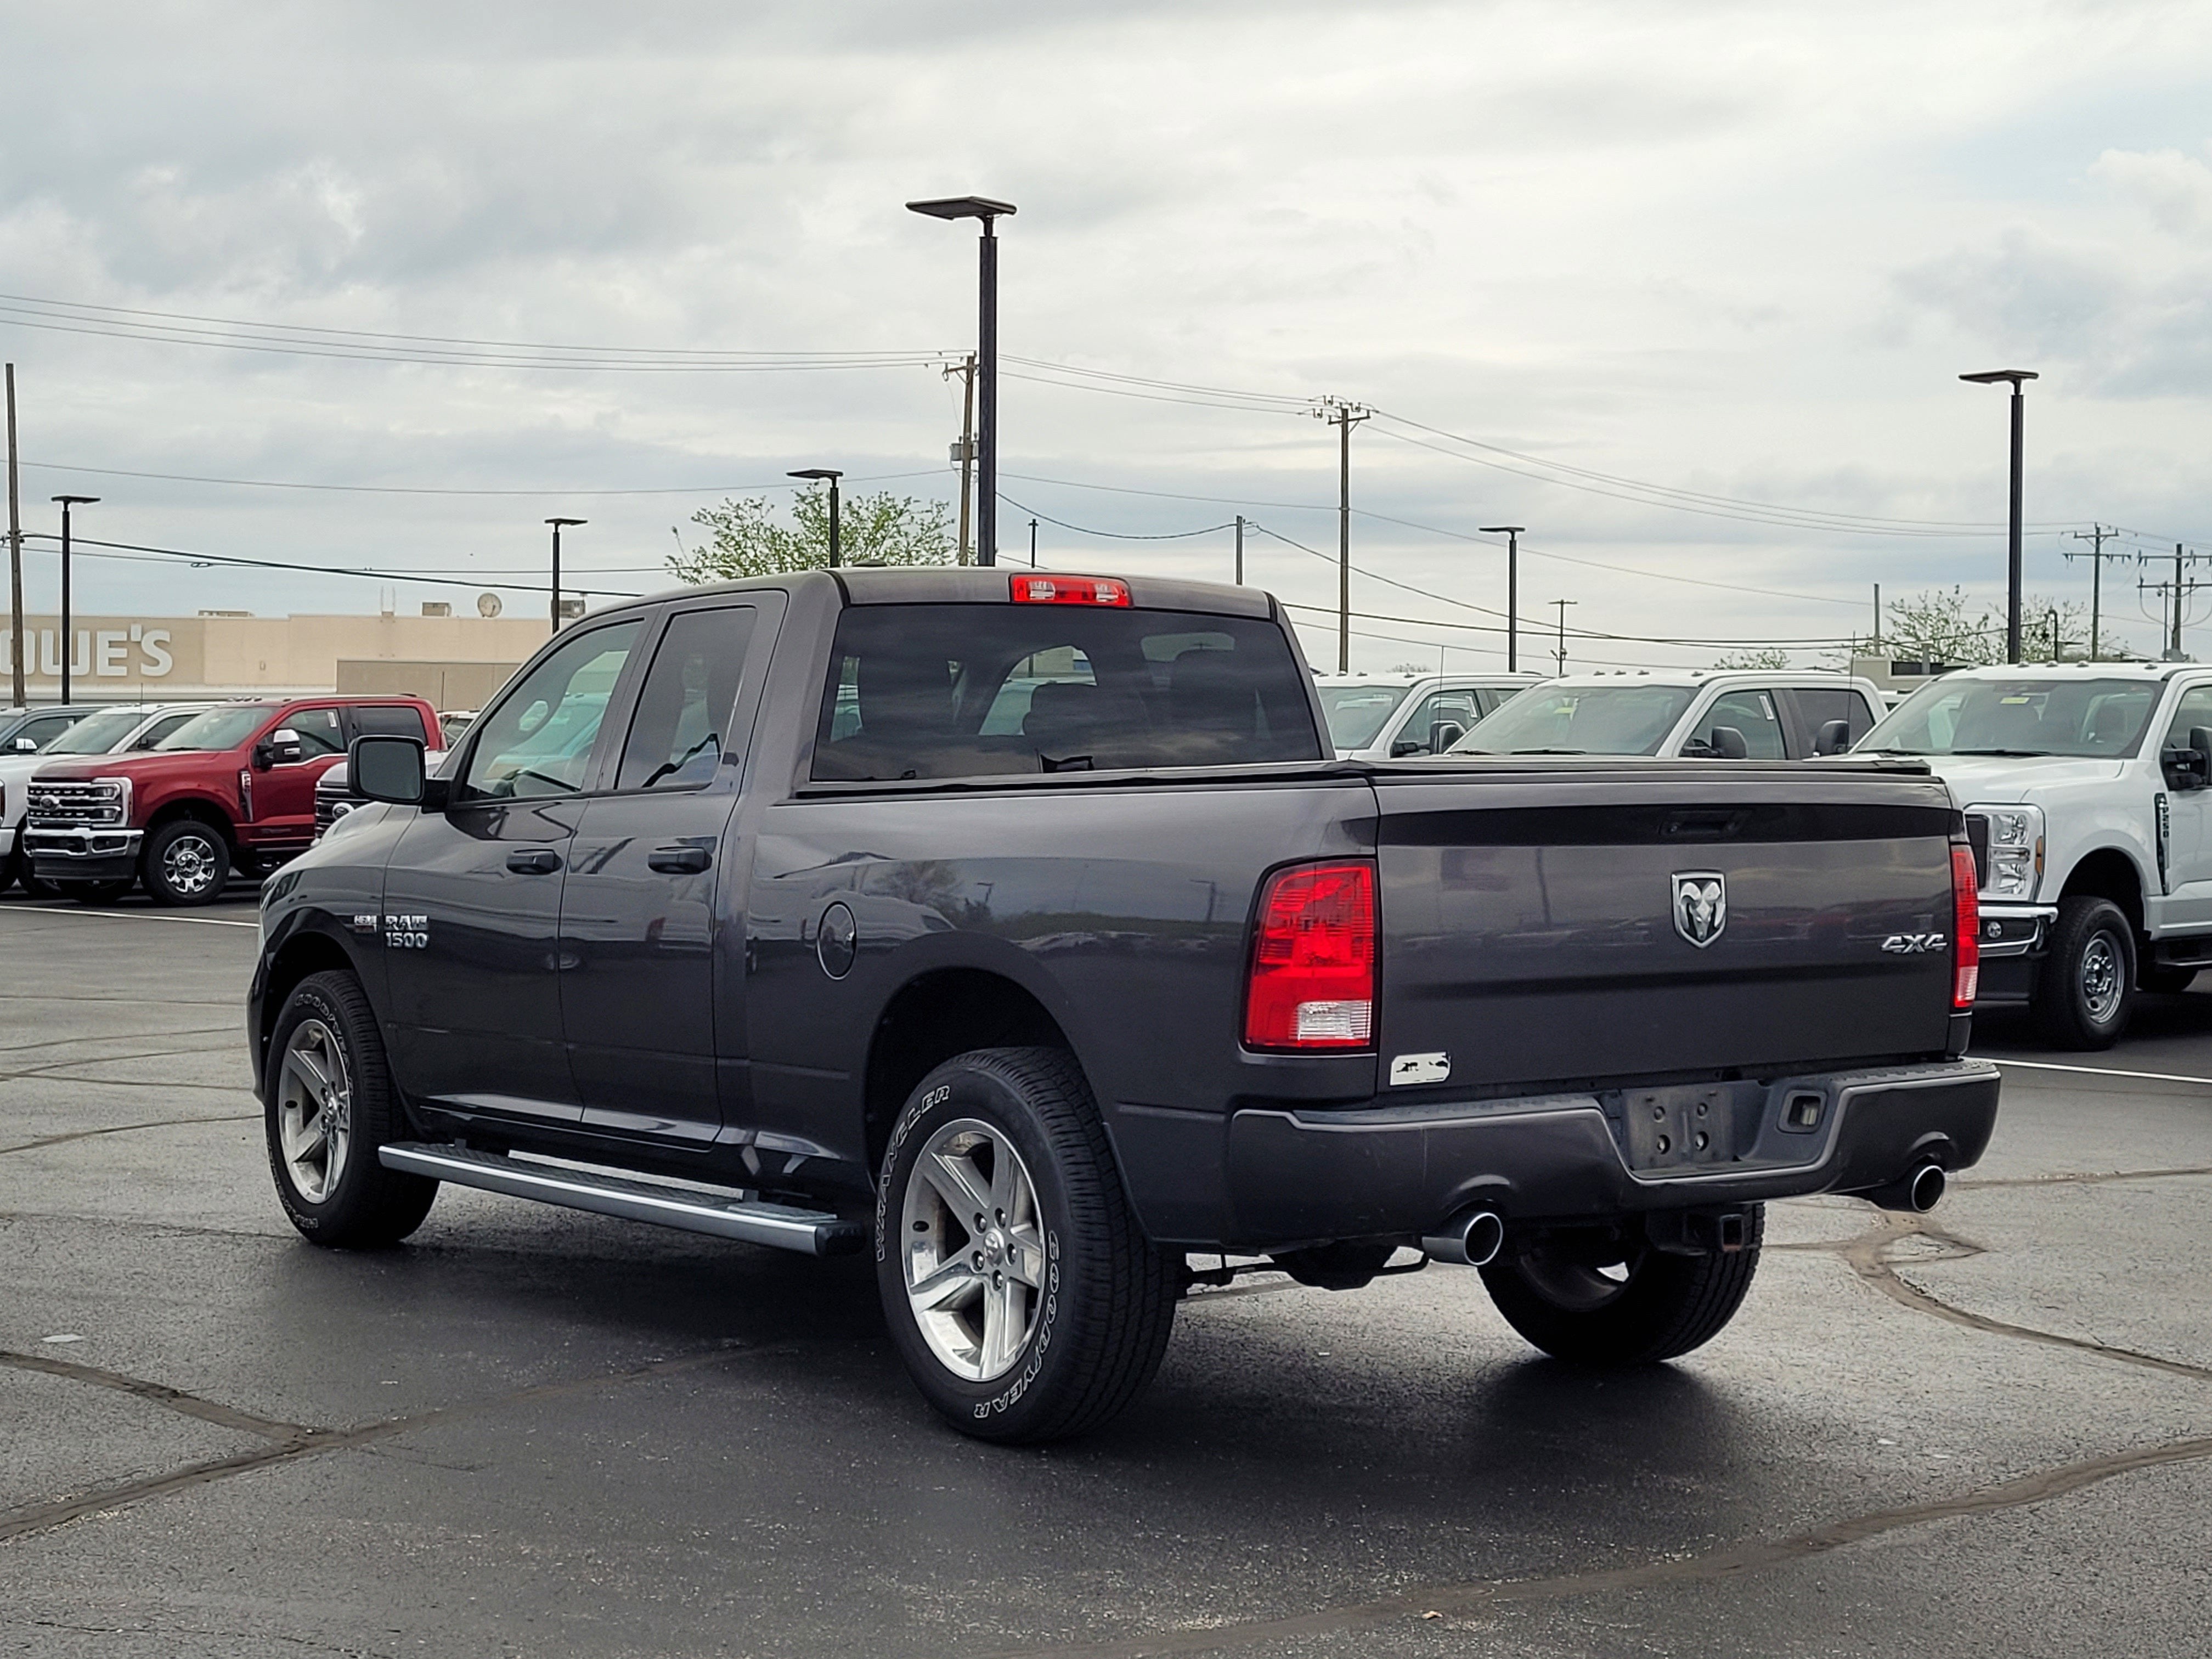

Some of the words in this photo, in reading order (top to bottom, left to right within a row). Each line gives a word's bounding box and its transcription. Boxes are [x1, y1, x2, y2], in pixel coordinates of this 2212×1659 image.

[385, 915, 428, 931] RAM
[385, 932, 428, 948] 1500
[1881, 934, 1948, 953] 4X4
[876, 1085, 950, 1262] WRANGLER
[974, 1230, 1060, 1418] GOODYEAR
